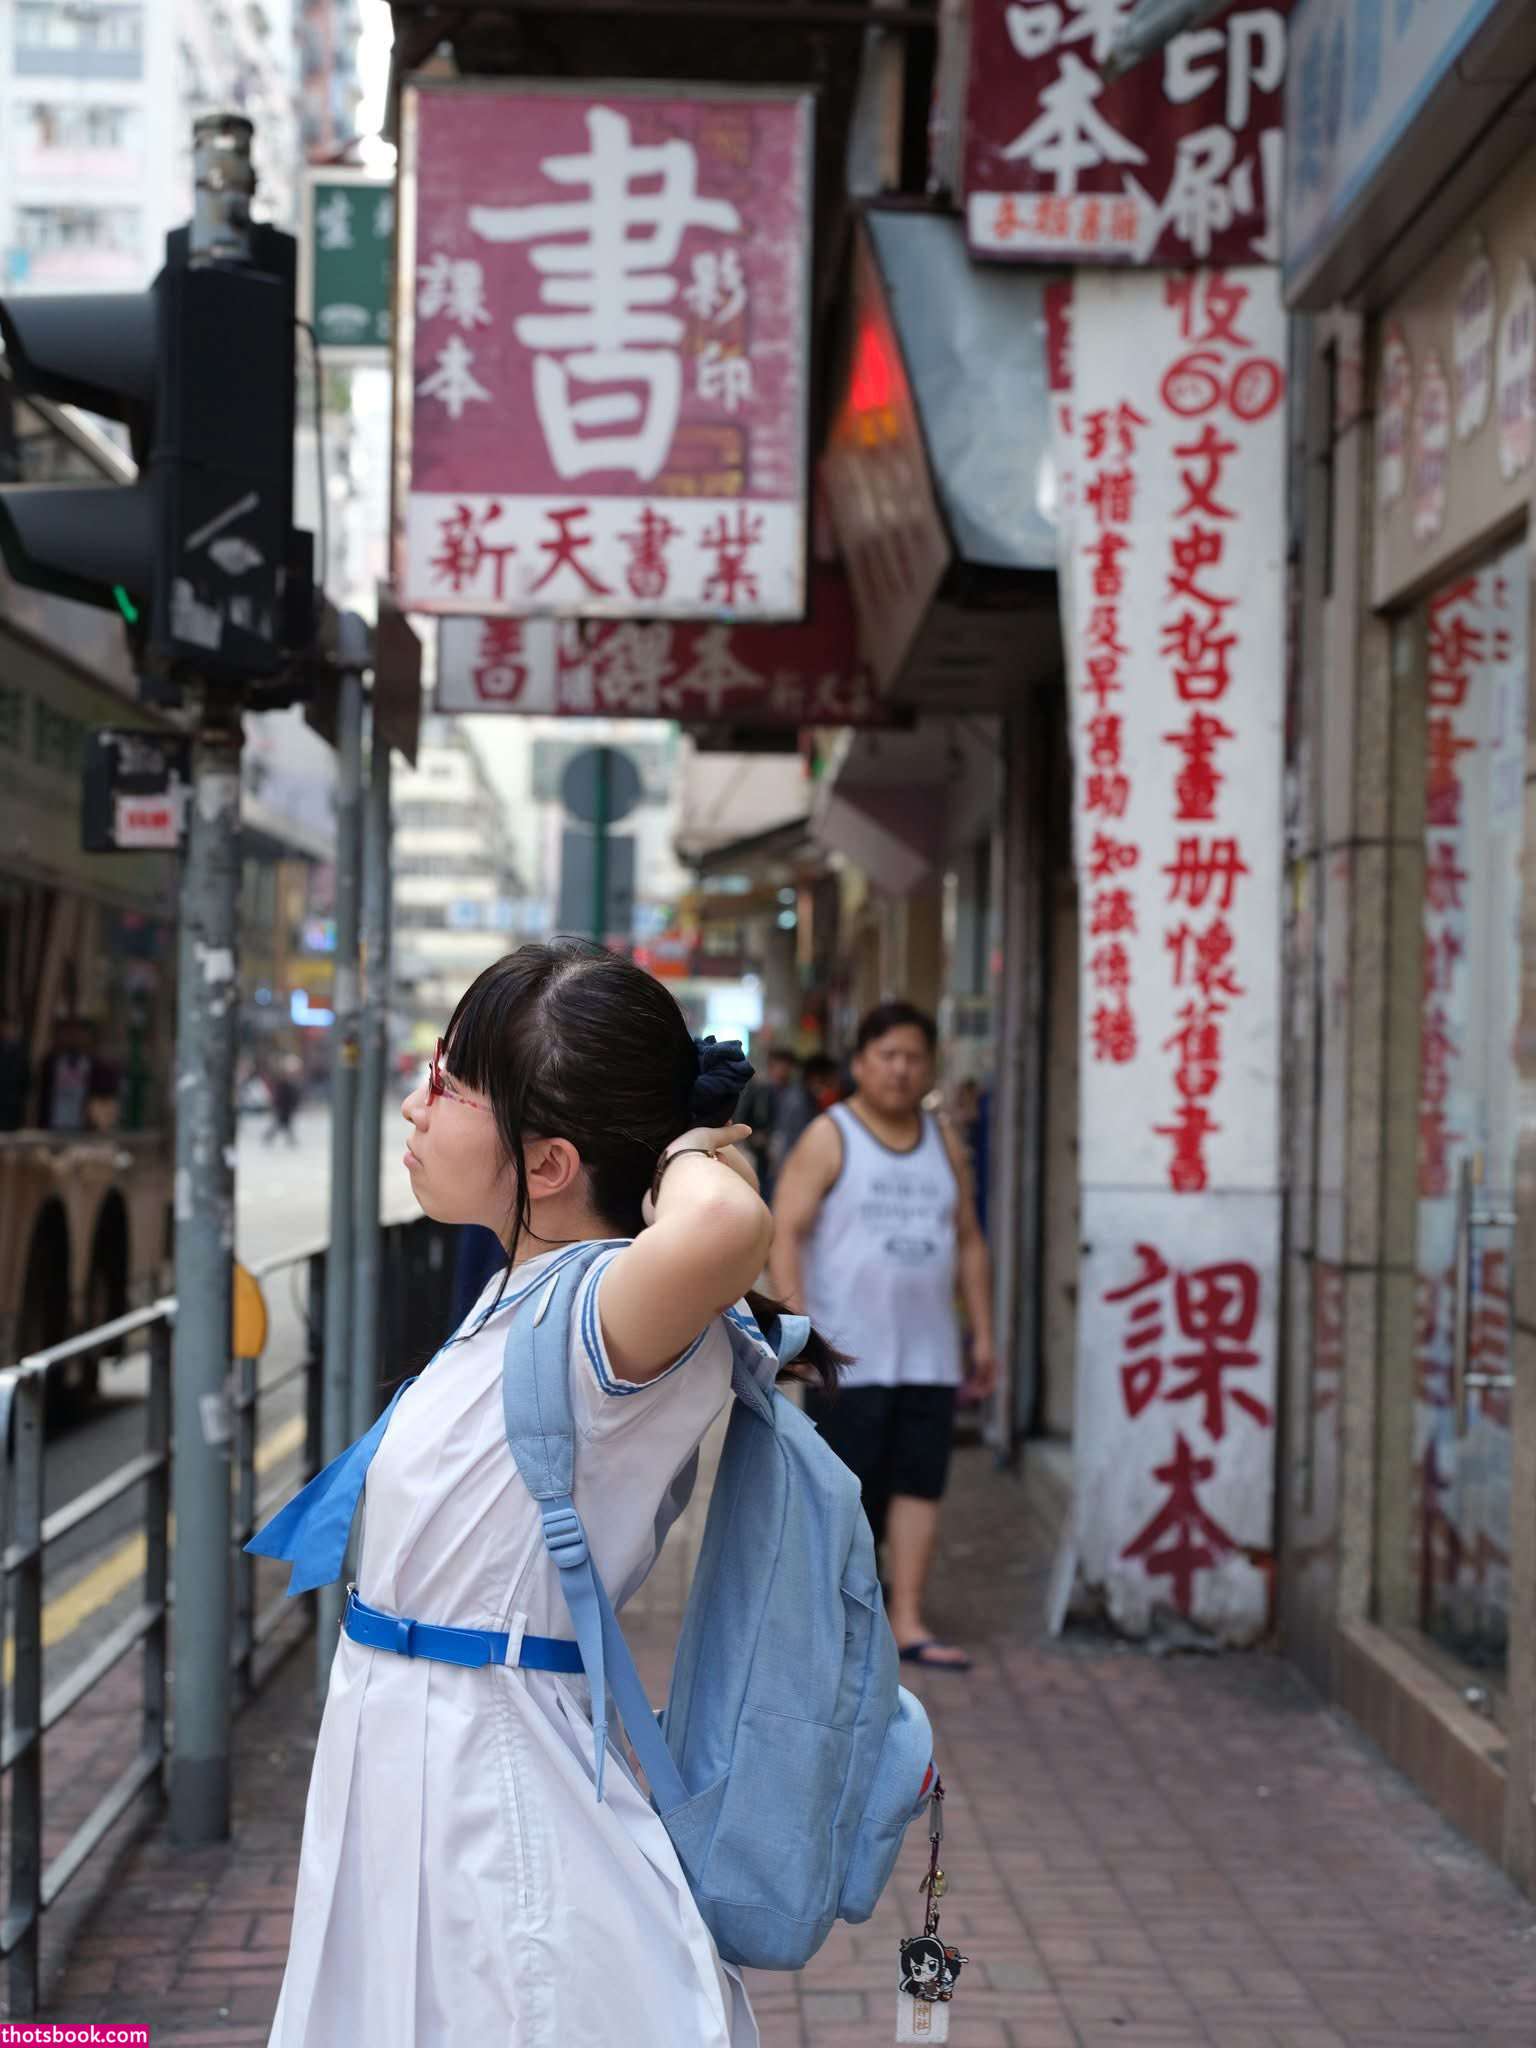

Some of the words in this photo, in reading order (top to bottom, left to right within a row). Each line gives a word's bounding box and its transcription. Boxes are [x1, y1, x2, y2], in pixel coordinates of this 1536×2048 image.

[1163, 8, 1288, 262] 印刷
[417, 252, 493, 420] 課本
[467, 105, 741, 479] 書
[684, 247, 755, 413] 影印
[430, 501, 768, 606] 新天書業
[1103, 1242, 1274, 1620] 課本
